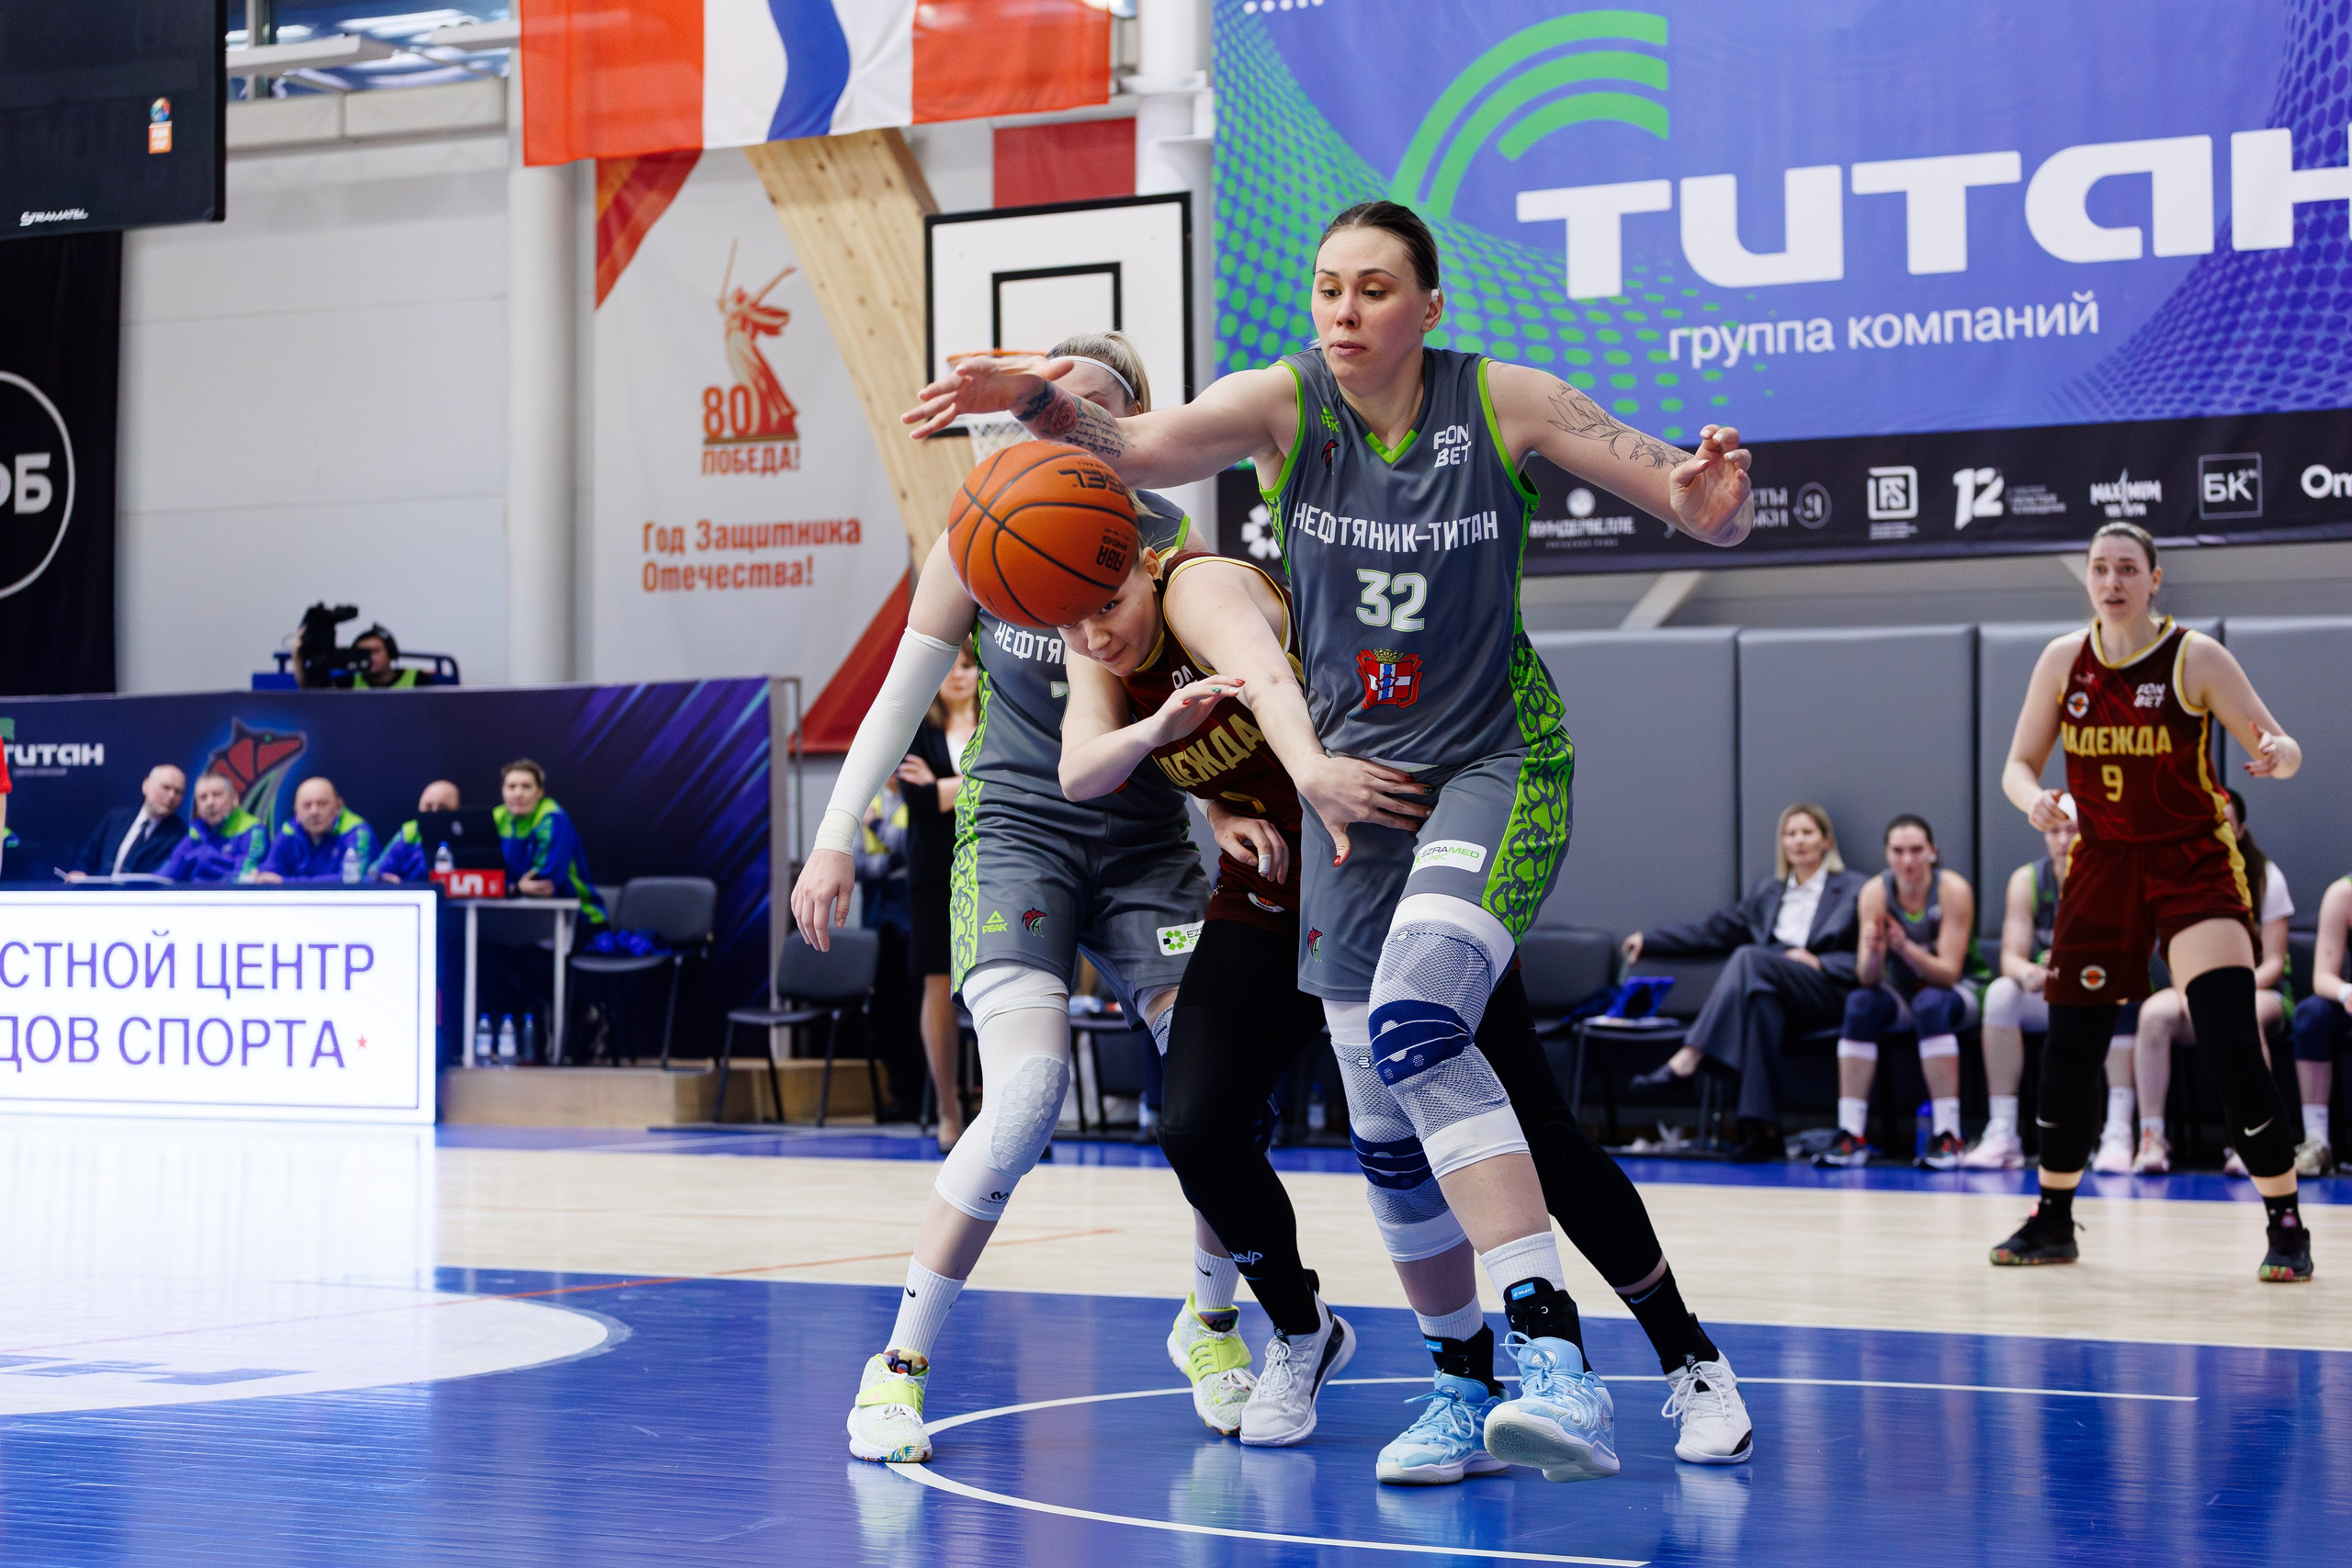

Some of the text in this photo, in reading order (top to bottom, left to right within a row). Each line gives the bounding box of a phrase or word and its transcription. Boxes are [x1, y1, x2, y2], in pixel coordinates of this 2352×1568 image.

[1669, 289, 2099, 368] группа компаний
[1433, 423, 1469, 449] FON
[1434, 441, 1472, 468] BET
[702, 446, 799, 477] ПОБЕДА!
[0, 452, 52, 514] Б
[1953, 467, 2004, 531] 12
[643, 518, 861, 555] Год Защитника
[1293, 502, 1498, 553] НЕФТЯНИК-ТИТАН
[643, 555, 814, 592] Отечества!
[1356, 568, 1427, 632] 32
[994, 621, 1066, 665] НЕФТЯ
[2102, 764, 2123, 802] 9
[1419, 853, 1448, 863] CLINIC
[1421, 846, 1480, 859] EZRAMED
[982, 921, 1008, 934] PEAK
[0, 931, 375, 999] СТНОЙ ЦЕНТР
[119, 1016, 346, 1069] СПОРТА
